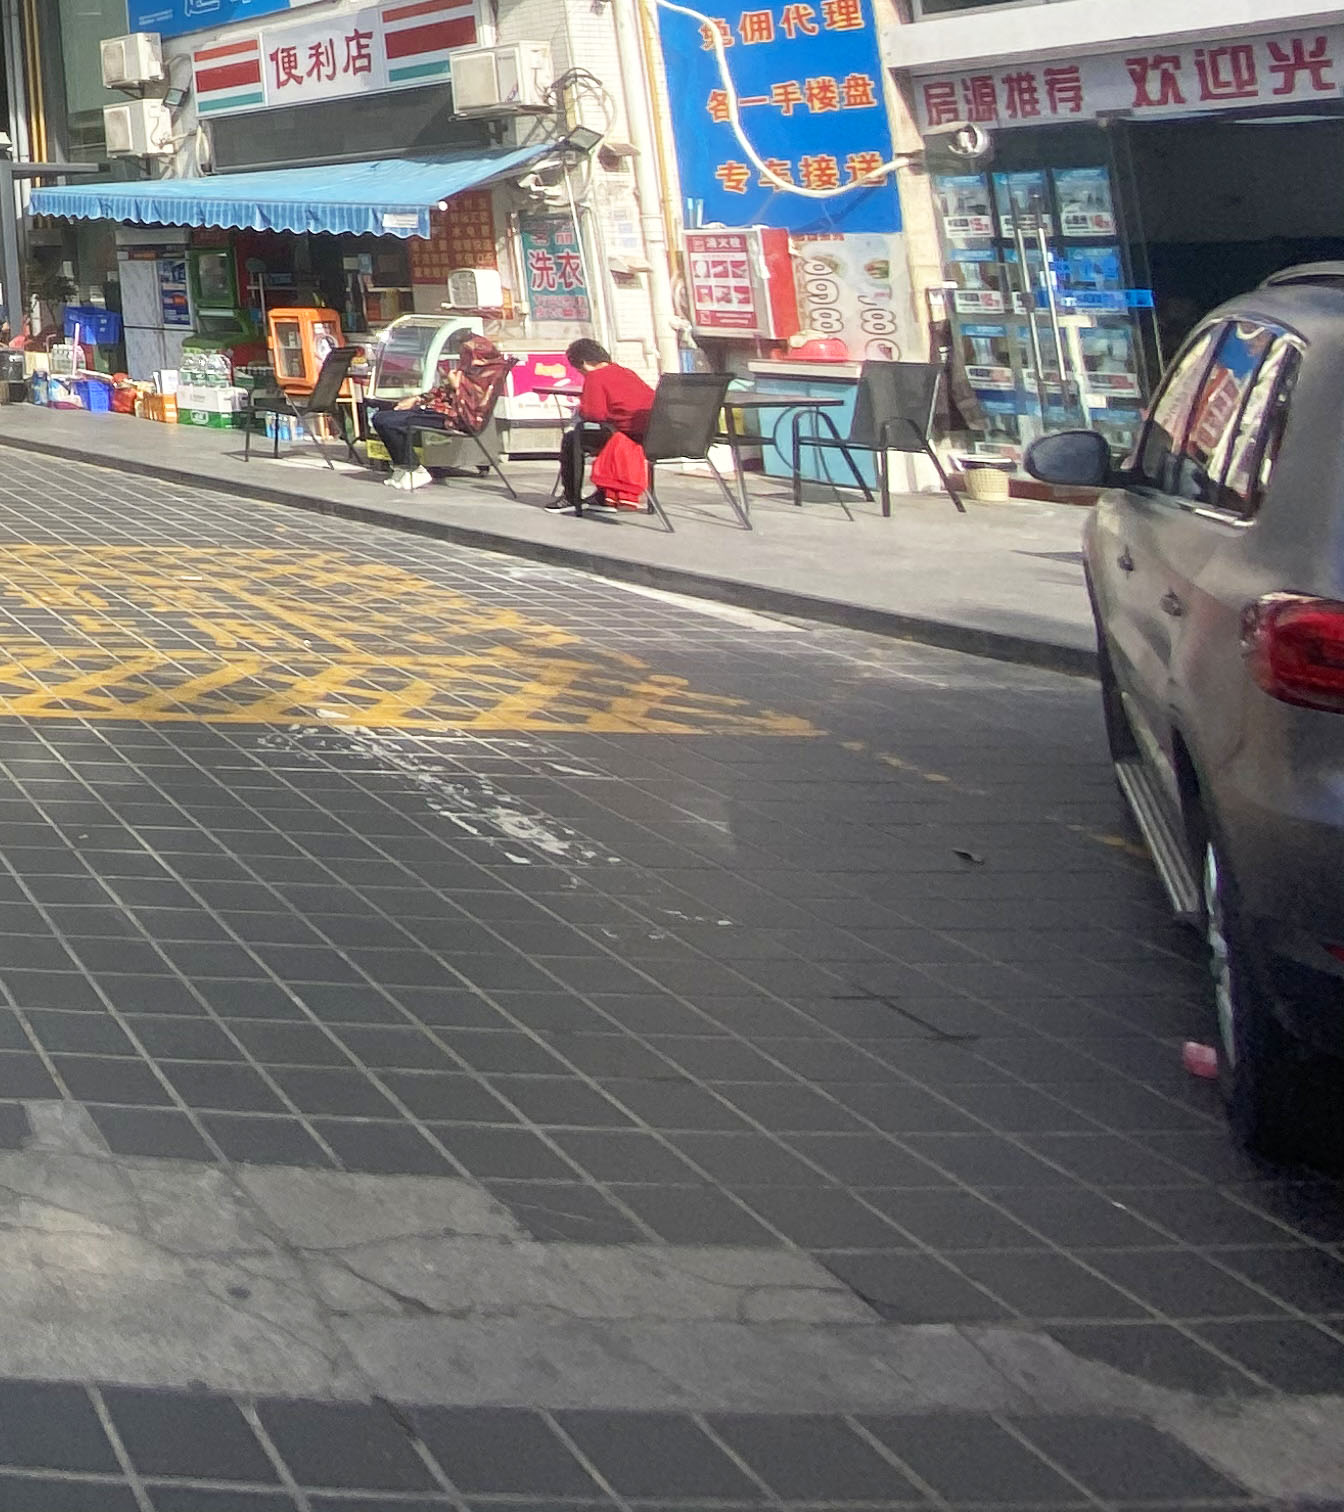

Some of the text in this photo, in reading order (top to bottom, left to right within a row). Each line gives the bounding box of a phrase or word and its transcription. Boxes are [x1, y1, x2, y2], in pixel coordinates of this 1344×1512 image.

[269, 27, 374, 91] 便利店
[1124, 35, 1337, 108] 欢迎光
[714, 150, 890, 196] 专车接送
[527, 248, 586, 292] 洗衣
